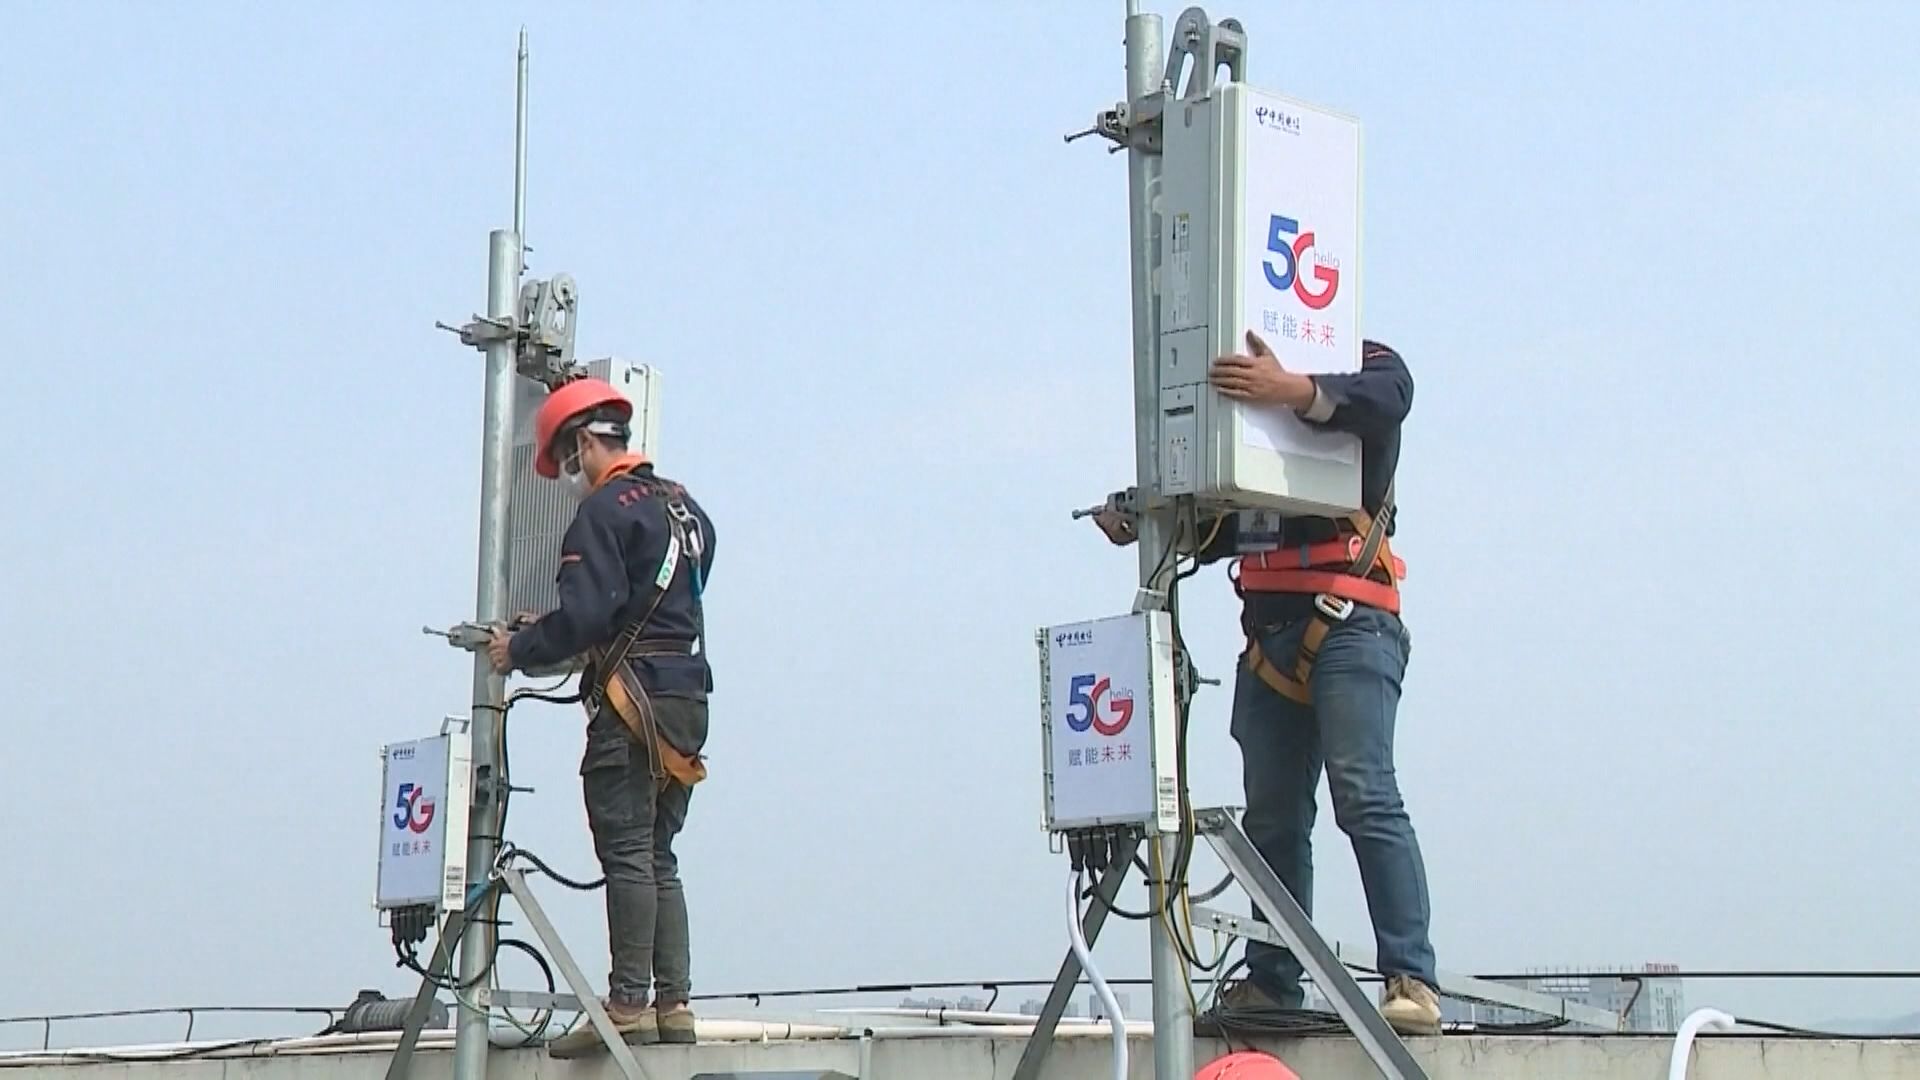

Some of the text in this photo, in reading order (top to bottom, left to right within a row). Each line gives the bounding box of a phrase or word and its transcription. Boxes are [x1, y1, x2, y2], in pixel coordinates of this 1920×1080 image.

[1263, 214, 1339, 309] 5G
[1314, 249, 1340, 268] hello
[1263, 309, 1336, 347] 赋能未来
[1066, 673, 1134, 736] 5G
[1110, 687, 1134, 699] hello
[1068, 744, 1133, 767] 赋能未来
[393, 783, 435, 834] 5G
